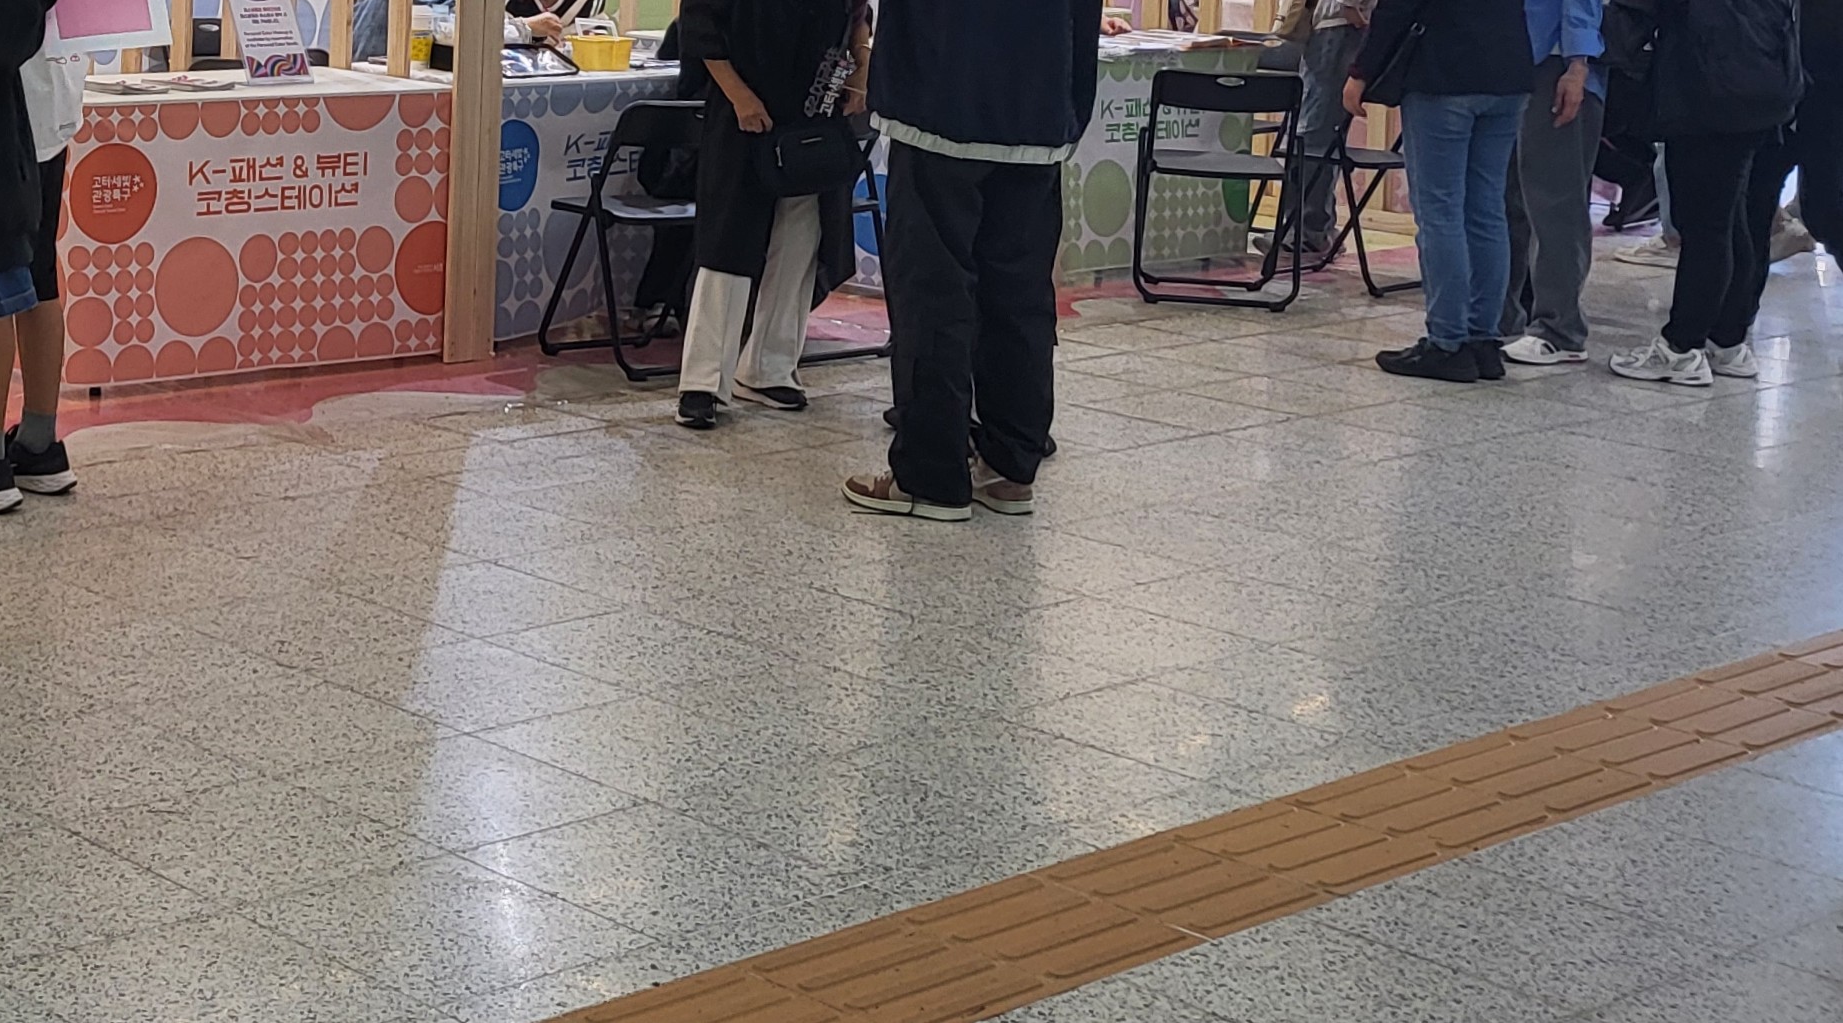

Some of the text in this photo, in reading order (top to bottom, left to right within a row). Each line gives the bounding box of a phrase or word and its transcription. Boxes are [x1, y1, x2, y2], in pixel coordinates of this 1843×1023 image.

[188, 151, 369, 187] K-패션 & 뷰티
[196, 181, 360, 217] 코칭스테이션
